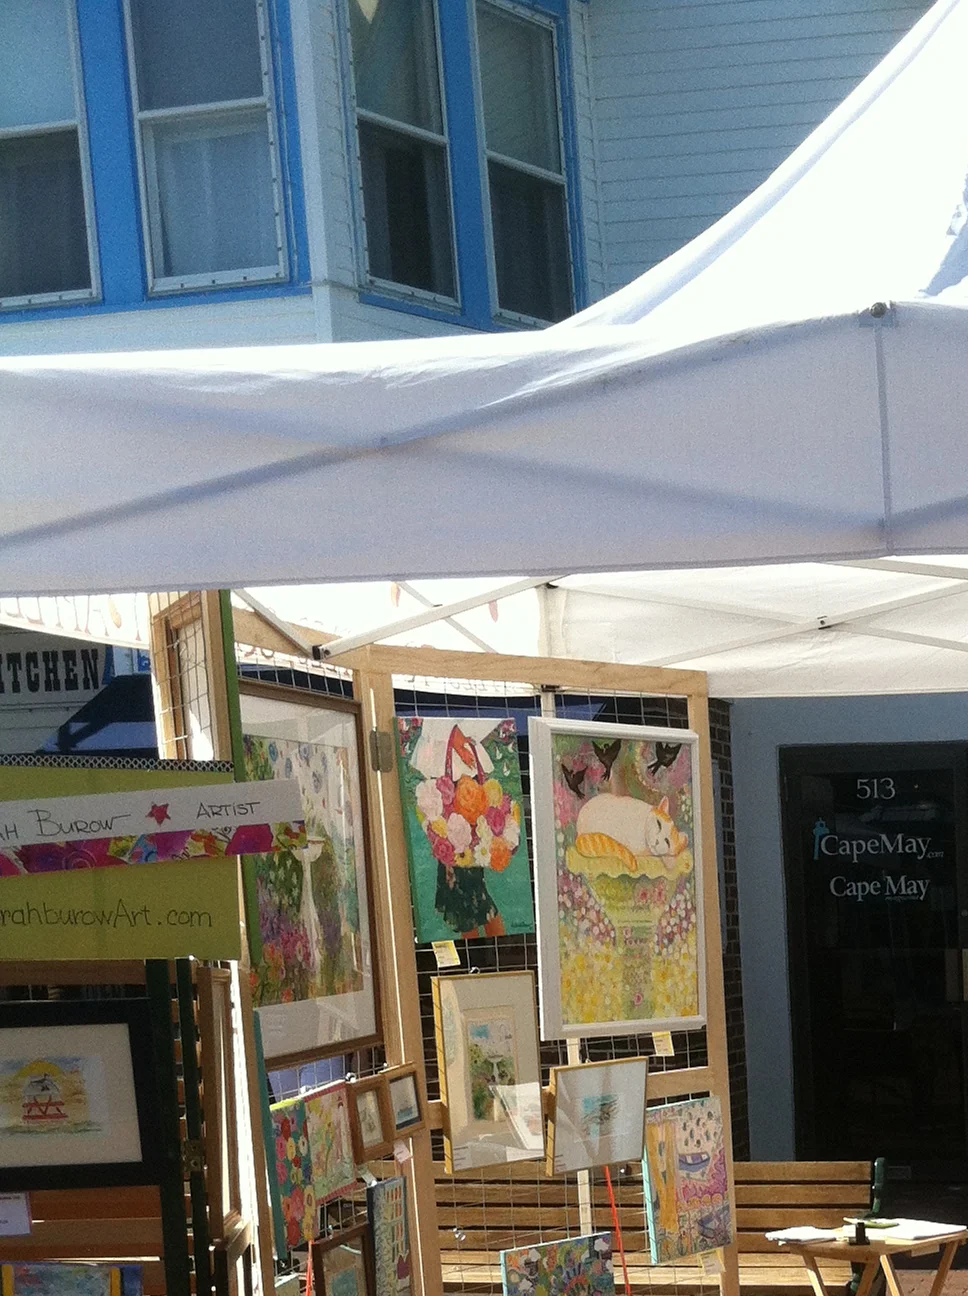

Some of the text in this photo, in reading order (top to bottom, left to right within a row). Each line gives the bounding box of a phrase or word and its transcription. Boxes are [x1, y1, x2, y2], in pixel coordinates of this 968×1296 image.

[856, 777, 896, 799] 513
[0, 823, 19, 840] H
[829, 875, 931, 901] Cape May
